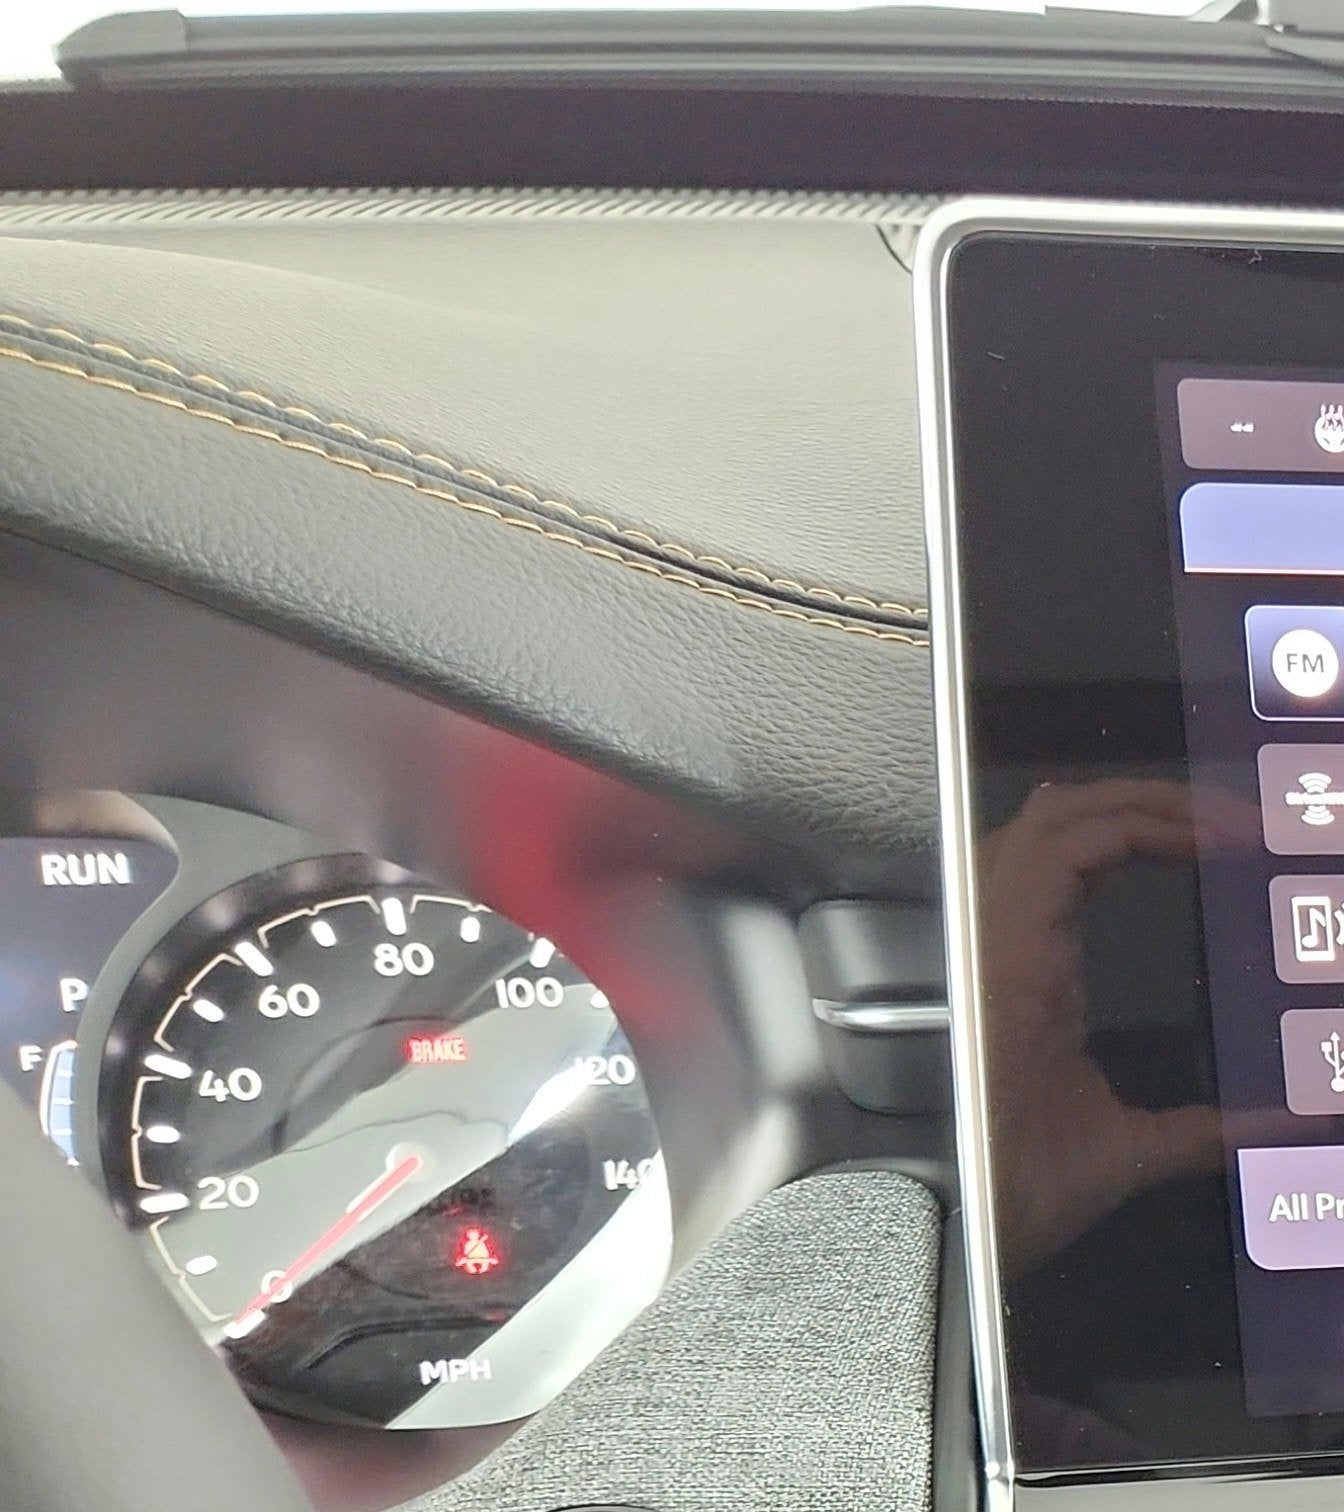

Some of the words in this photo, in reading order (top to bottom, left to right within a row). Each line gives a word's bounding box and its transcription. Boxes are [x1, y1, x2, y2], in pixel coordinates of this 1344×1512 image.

[1286, 652, 1326, 675] FM
[41, 852, 132, 886] RUN
[374, 942, 434, 977] 80
[60, 979, 88, 1012] P
[258, 983, 320, 1018] 60
[495, 977, 564, 1009] 100
[19, 1045, 43, 1072] F
[408, 1035, 466, 1064] BRAKE
[199, 1067, 262, 1103] 40
[198, 1175, 259, 1210] 20
[1268, 1192, 1309, 1222] All
[419, 1359, 492, 1385] MPH
